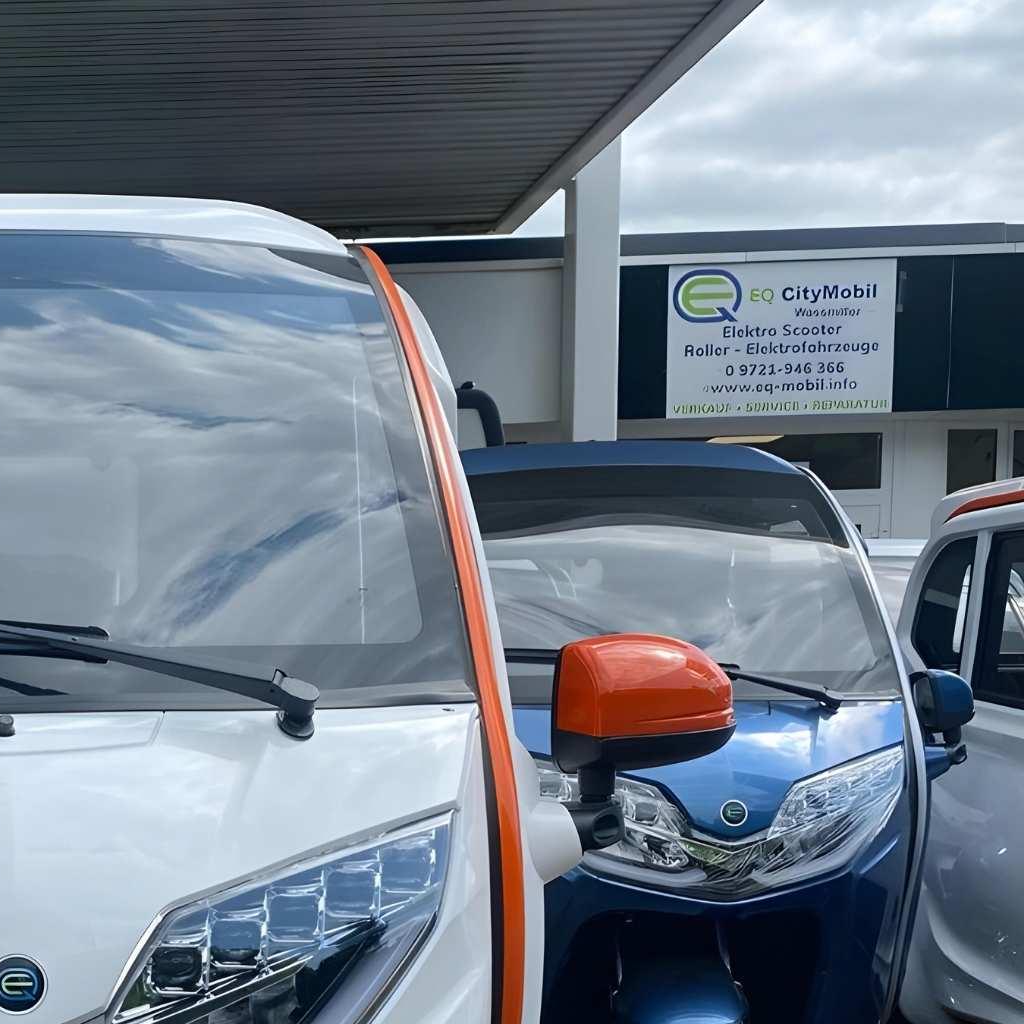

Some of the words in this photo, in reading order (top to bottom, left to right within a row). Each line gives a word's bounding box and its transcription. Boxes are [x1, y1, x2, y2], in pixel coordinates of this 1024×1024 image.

[750, 288, 774, 304] EQ
[782, 283, 877, 303] CityMobil
[722, 325, 777, 338] Elektro
[783, 324, 843, 337] Scooter
[684, 344, 730, 357] Roller
[746, 340, 879, 355] Elektrofahrzeuge
